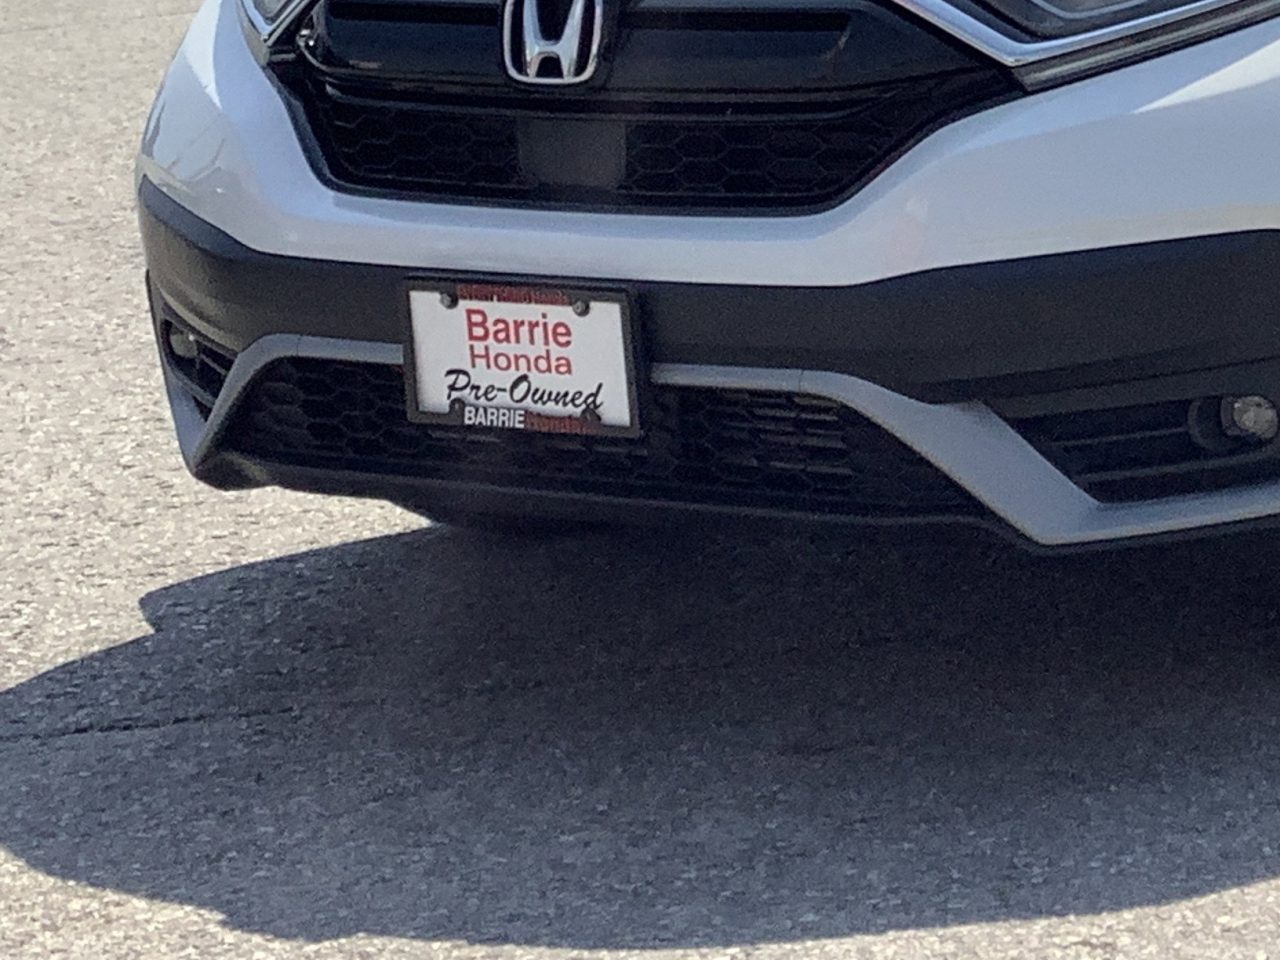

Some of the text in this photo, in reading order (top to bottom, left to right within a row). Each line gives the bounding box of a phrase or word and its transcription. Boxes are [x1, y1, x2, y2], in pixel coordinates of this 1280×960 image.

[465, 308, 573, 348] Barrie
[469, 344, 573, 376] Honda
[444, 368, 604, 409] Pre-Owned
[464, 406, 525, 429] BARRIE
